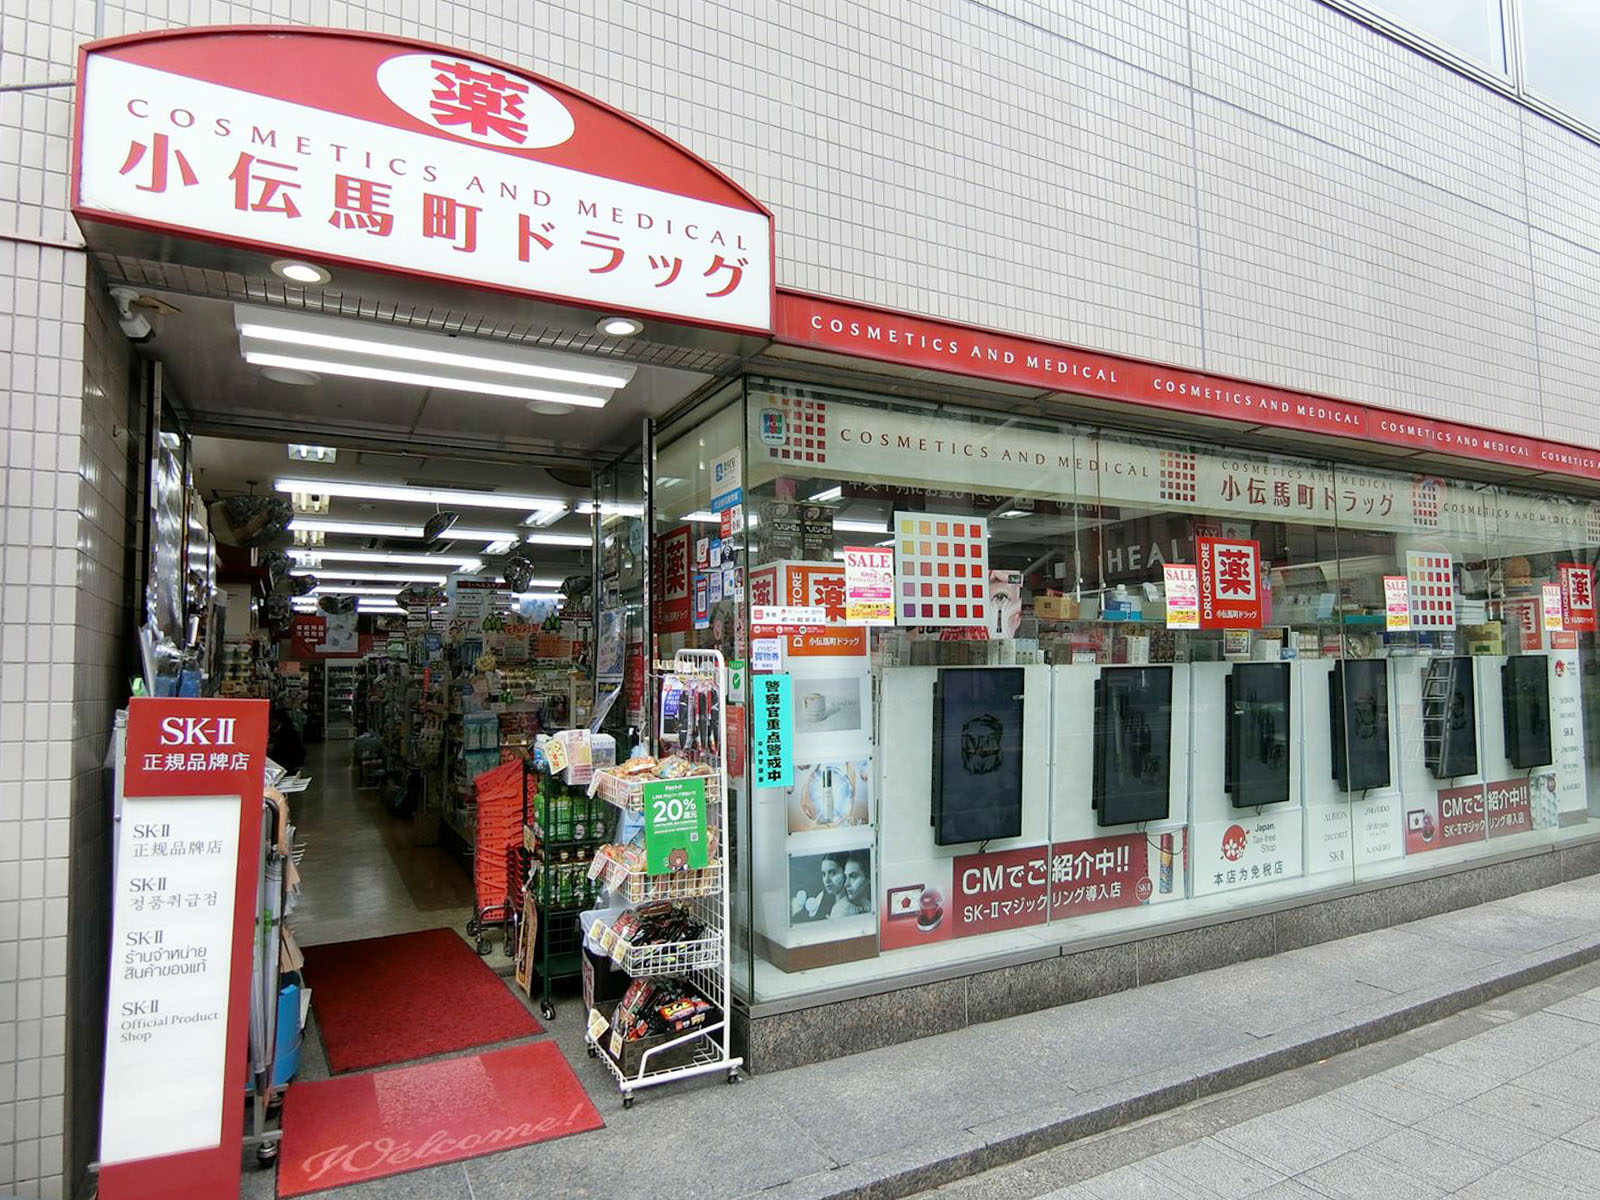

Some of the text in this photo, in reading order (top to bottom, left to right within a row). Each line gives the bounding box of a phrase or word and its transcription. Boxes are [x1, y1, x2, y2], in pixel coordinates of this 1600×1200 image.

[430, 59, 529, 144] 薬
[127, 98, 748, 251] COSMETICS AND MEDICAL
[118, 131, 750, 298] 小伝馬町ドラッグ
[811, 315, 1118, 383] COSMETICS AND MEDICAL
[1153, 378, 1360, 425] COSMETICS AND MEDICAL
[840, 428, 1150, 478] COSMETICS AND MEDICAL
[1381, 420, 1530, 456] COSMETICS AND MEDICAL
[1222, 460, 1394, 490] COSMETICS AND MEDICAL
[1541, 450, 1595, 468] COSMETICS
[1220, 475, 1394, 517] 小伝馬町ドラッグ
[1443, 502, 1509, 519] COSMETICS
[1515, 511, 1535, 522] AND
[847, 553, 891, 568] SALE
[1107, 539, 1194, 574] HEAL
[1218, 549, 1252, 595] 薬
[1166, 569, 1195, 581] SALE
[1201, 543, 1213, 619] DRUGSTORE
[1385, 581, 1407, 591] SALE
[1571, 571, 1591, 606] 薬
[808, 635, 861, 647] 小伝馬町ドラッグ
[161, 717, 236, 746] SK-II
[765, 680, 782, 782] 警察官重点警戒中
[142, 752, 250, 771] 正規品牌店
[652, 798, 697, 823] 20%
[1323, 810, 1348, 822] ALBION
[1442, 785, 1528, 818] CMでご紹介中!!
[1261, 843, 1277, 854] Shop
[962, 846, 1130, 895] CMでご紹介中!!
[1213, 860, 1284, 886] 本店为免税店
[120, 1011, 219, 1031] Official Product
[120, 1031, 152, 1042] Shop
[302, 1103, 584, 1182] Welcome!
